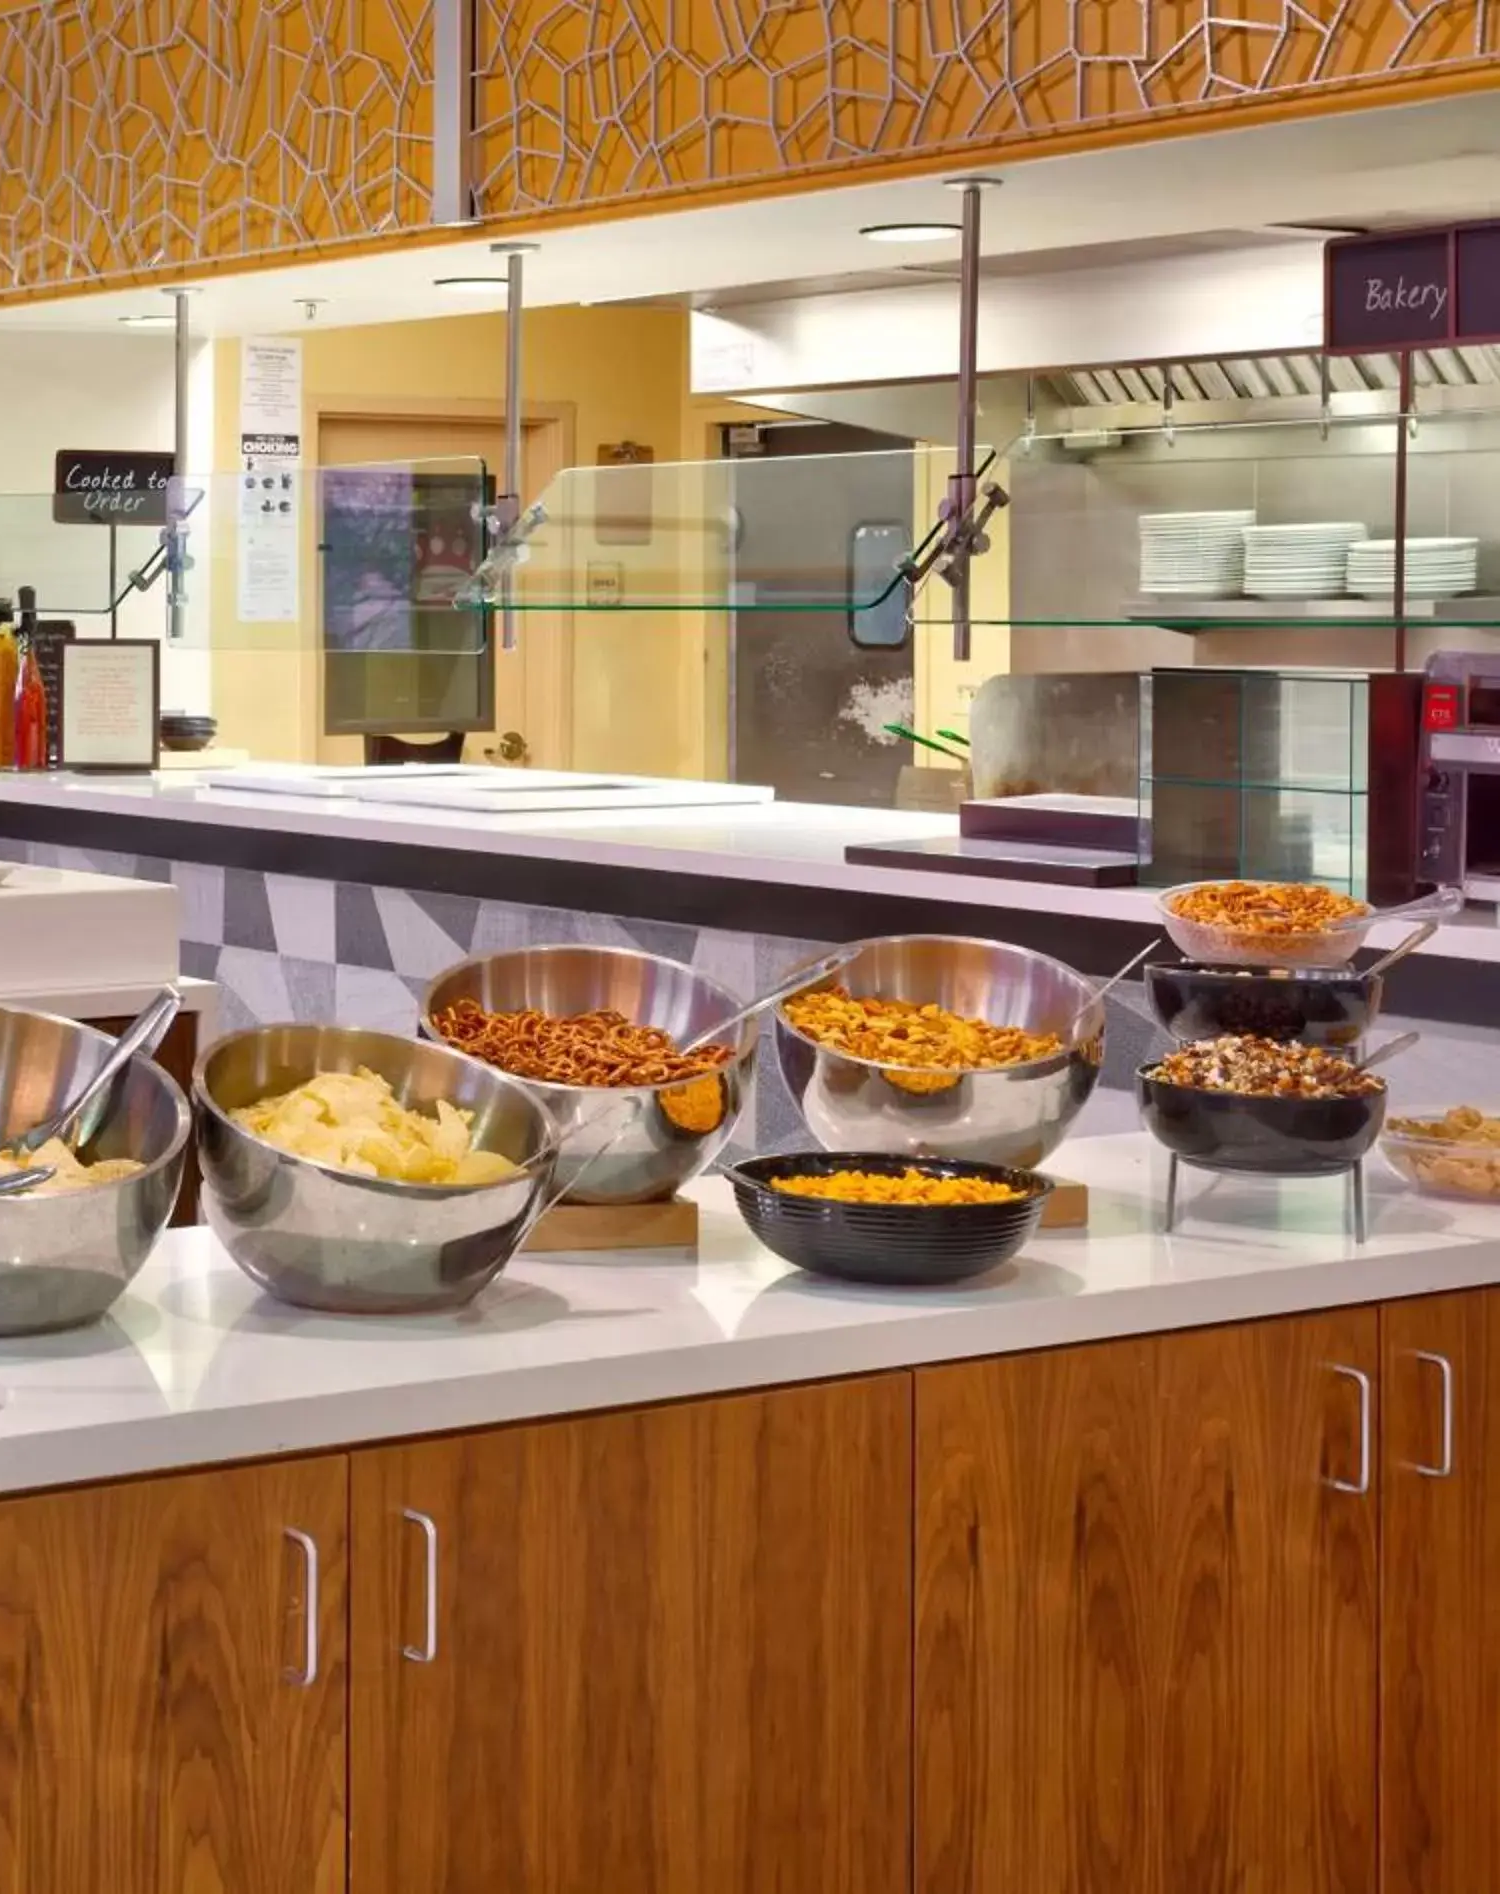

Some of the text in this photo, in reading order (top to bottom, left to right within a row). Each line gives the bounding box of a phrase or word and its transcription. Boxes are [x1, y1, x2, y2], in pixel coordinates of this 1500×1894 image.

[1365, 275, 1447, 320] Bakery
[65, 463, 168, 490] Cooked to
[83, 490, 146, 513] Order
